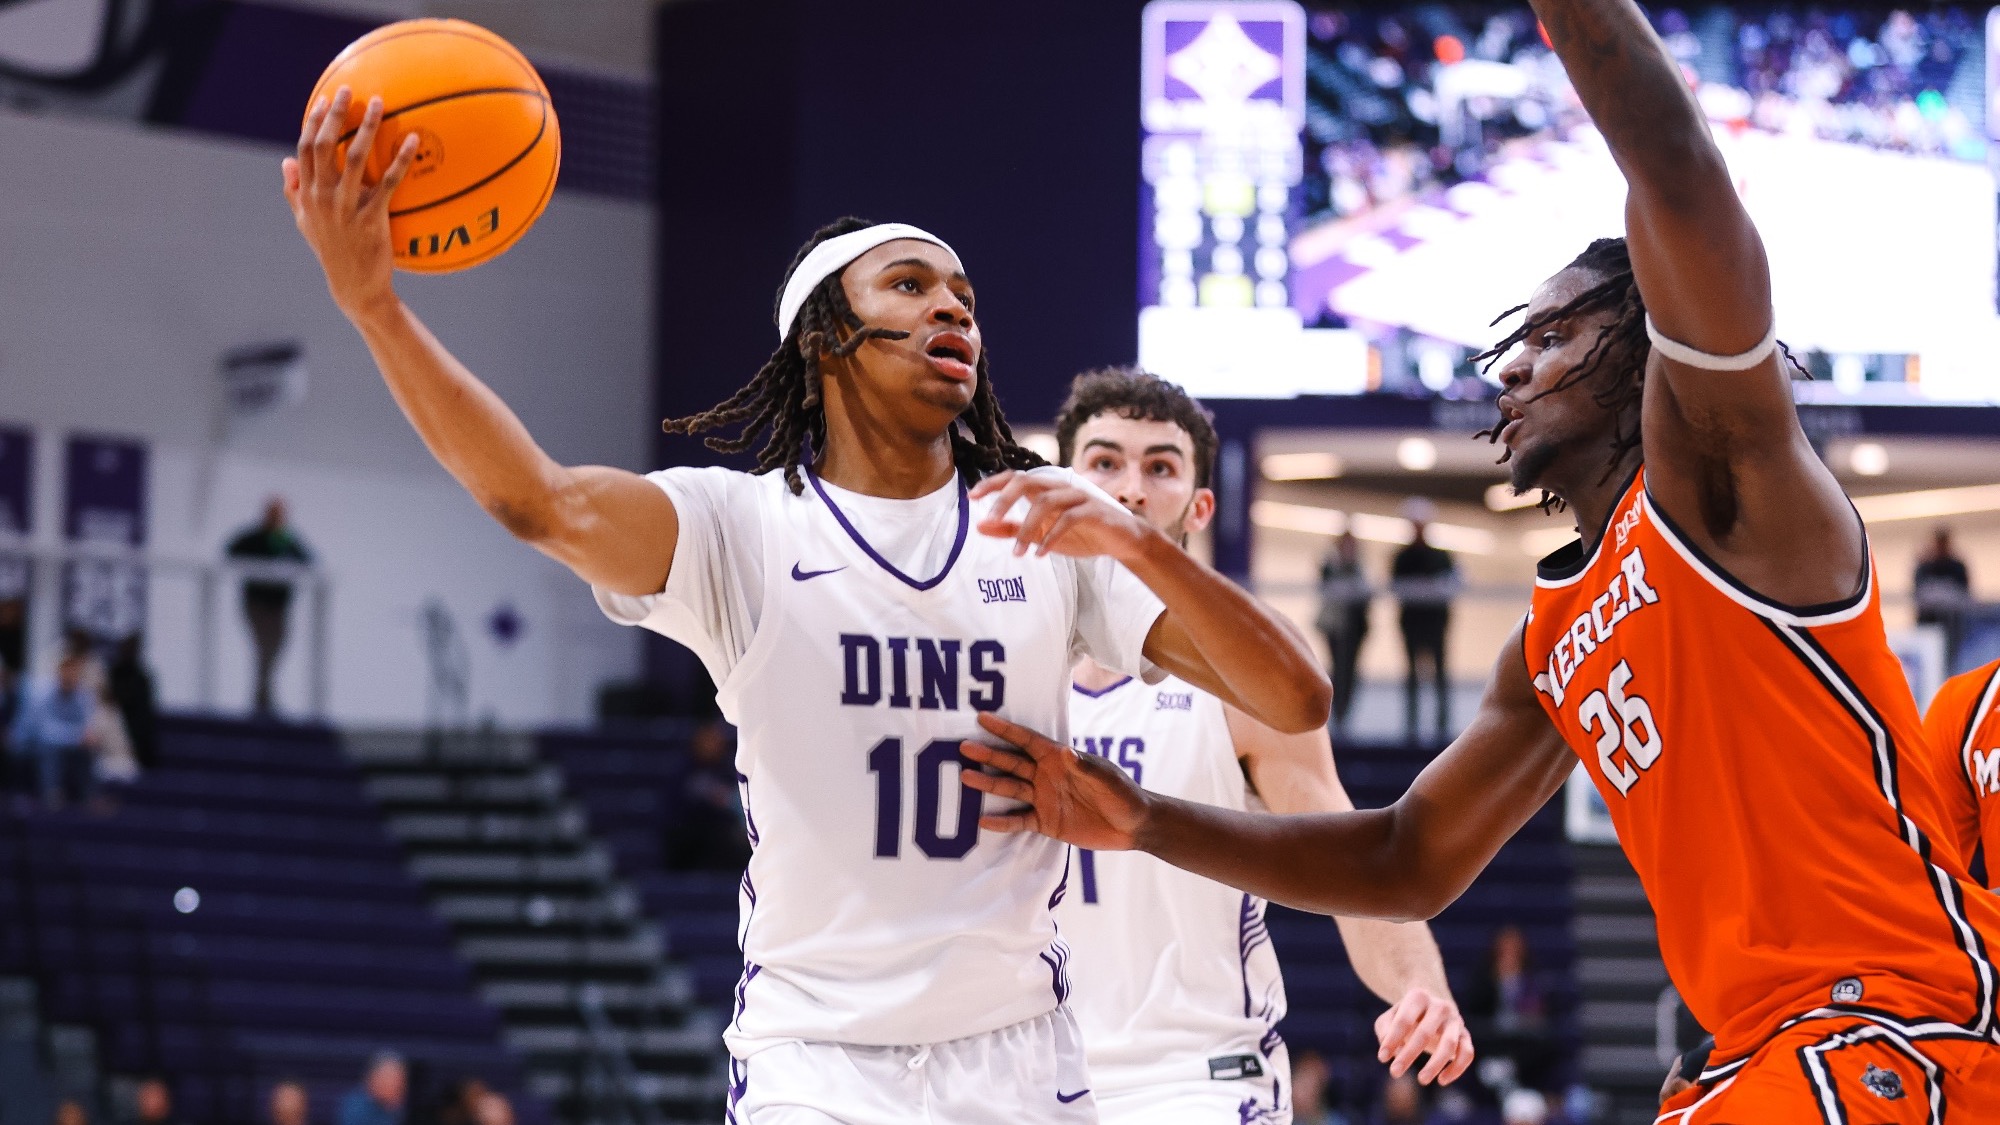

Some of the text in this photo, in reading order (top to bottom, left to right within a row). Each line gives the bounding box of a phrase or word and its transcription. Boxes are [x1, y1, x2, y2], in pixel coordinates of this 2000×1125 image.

[407, 205, 500, 258] EVO
[839, 631, 1006, 712] DINS
[1532, 545, 1661, 709] MERCER
[1577, 657, 1664, 799] 26
[866, 734, 986, 862] 10
